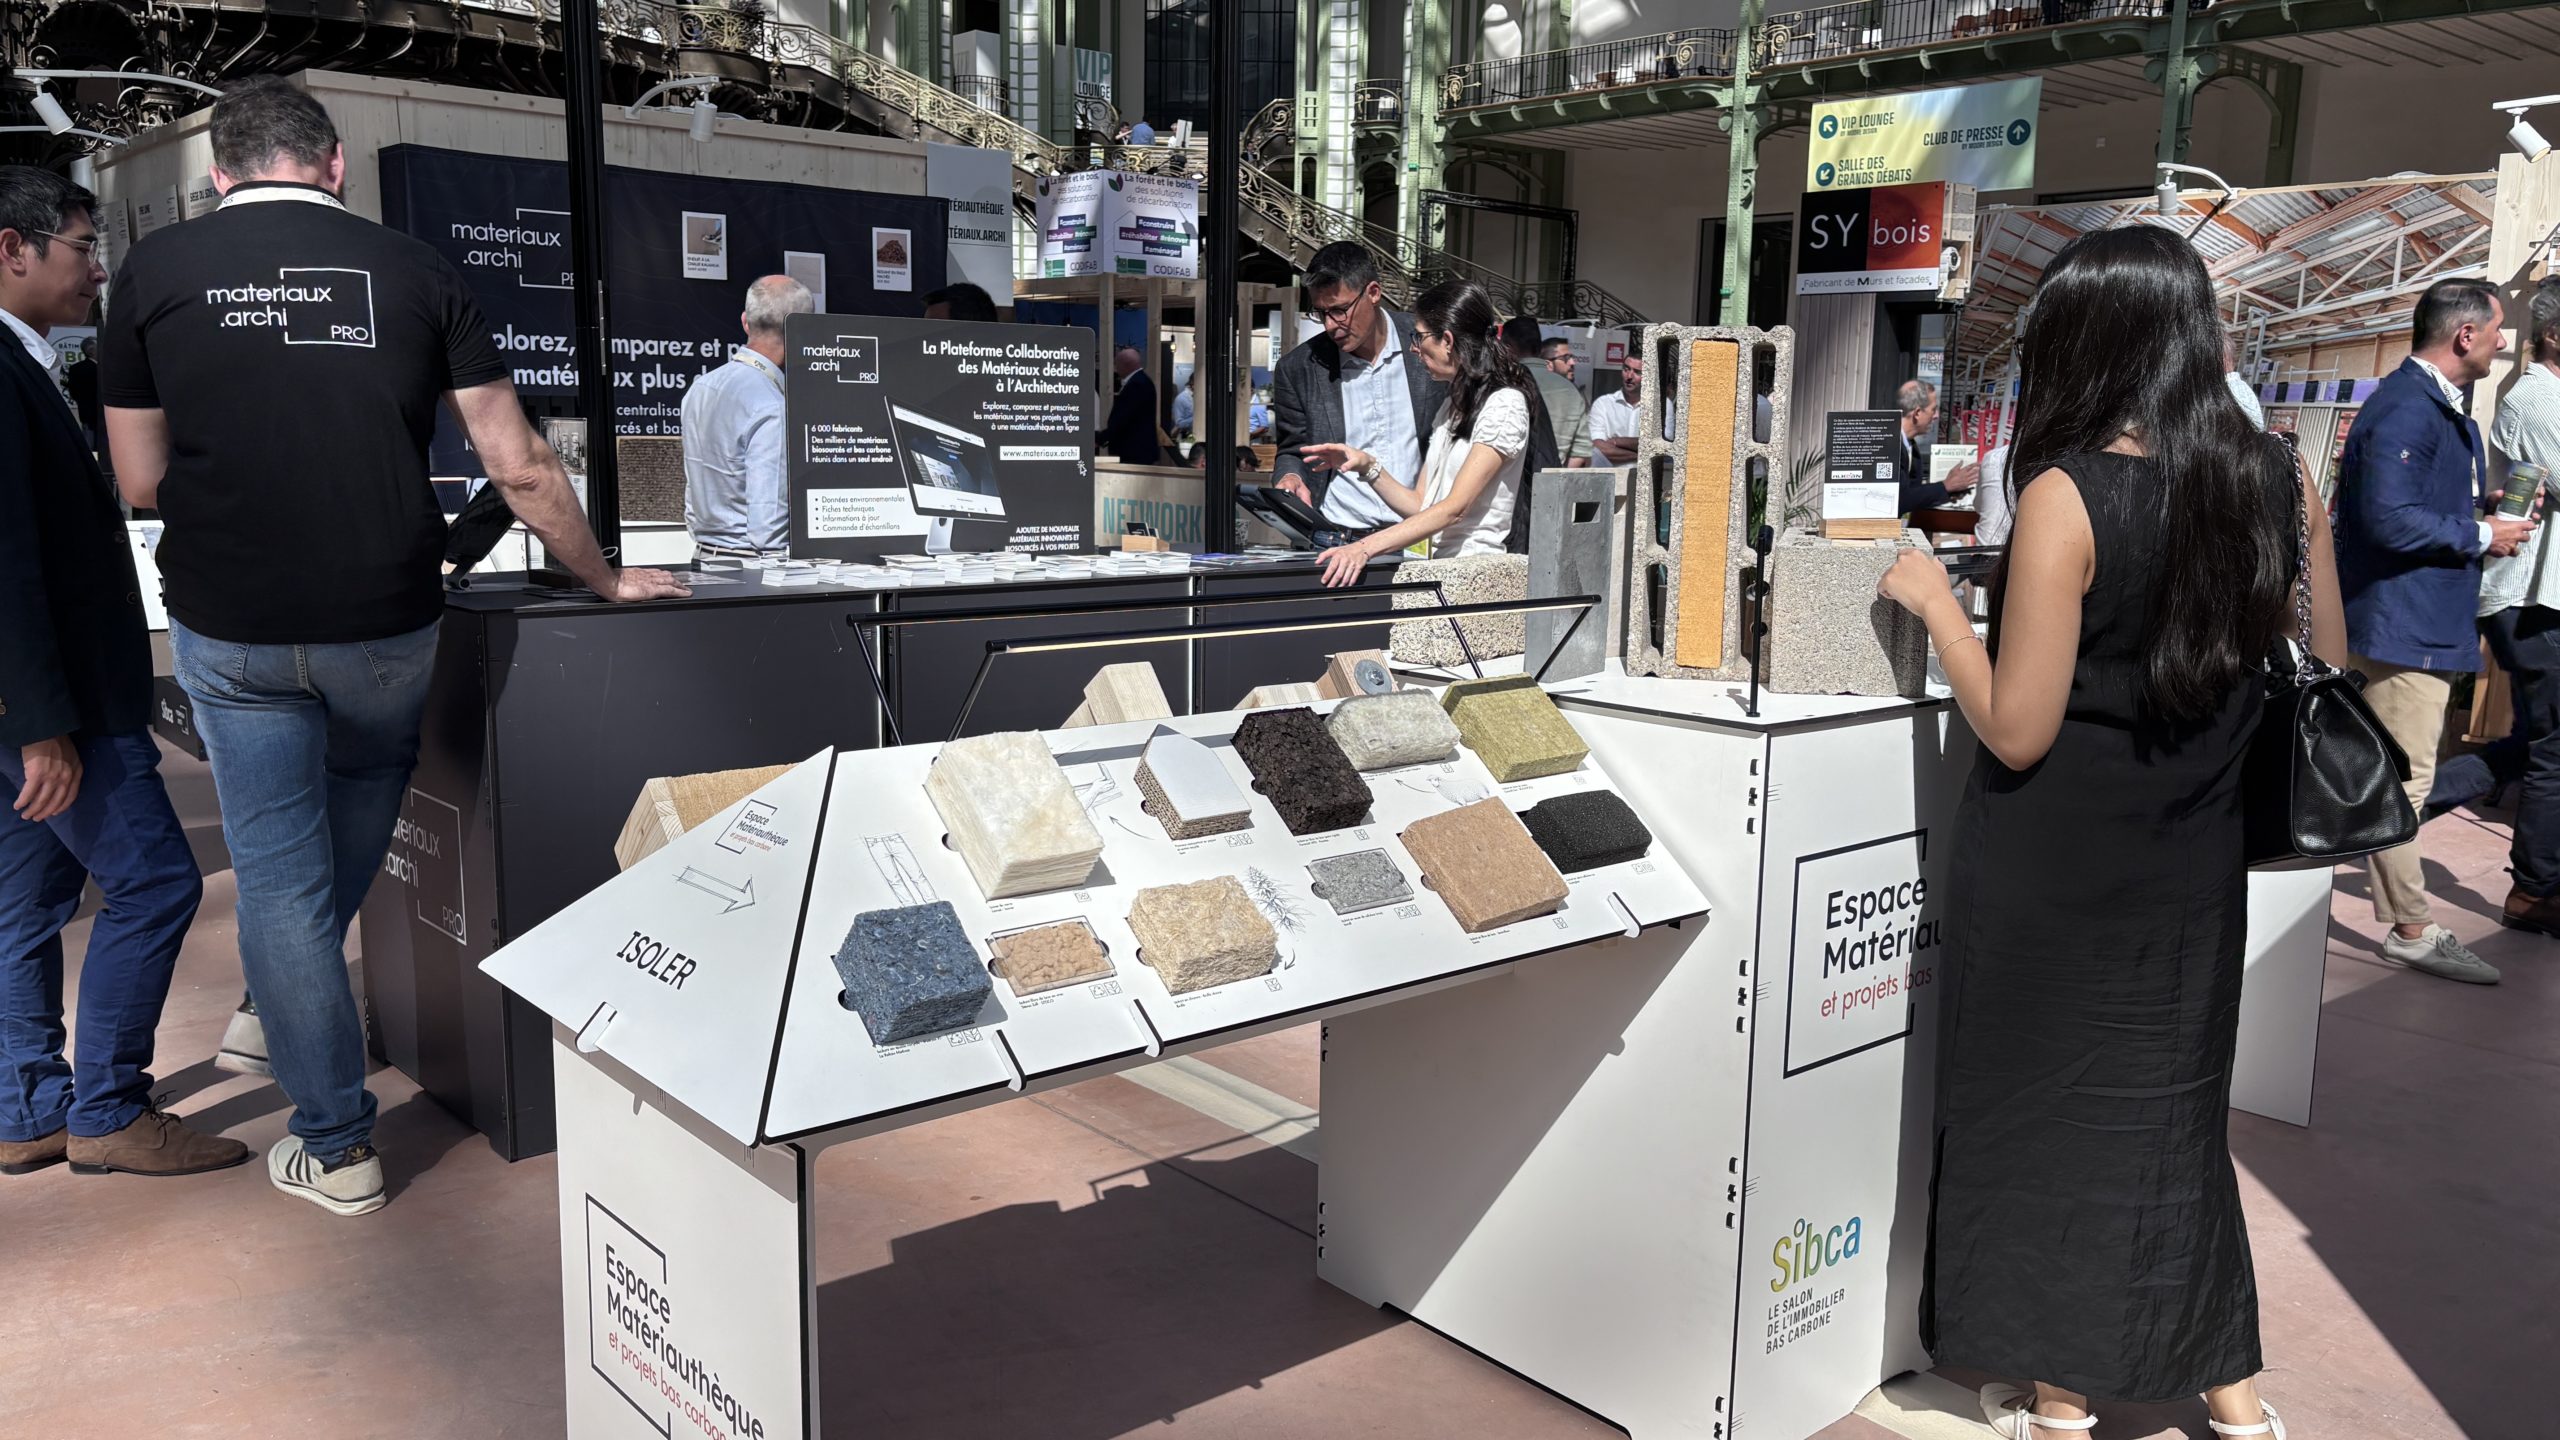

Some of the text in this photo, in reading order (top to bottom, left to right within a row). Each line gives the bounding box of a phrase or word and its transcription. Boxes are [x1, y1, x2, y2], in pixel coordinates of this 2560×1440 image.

[1076, 48, 1111, 83] VIP
[1078, 82, 1110, 98] LOUNGE
[1841, 112, 1895, 129] VIP LOUNGE
[1923, 125, 2004, 146] CLUB DE PRESSE
[1838, 156, 1884, 171] SALLE DES
[1124, 174, 1194, 190] La forêt et le bois,
[1837, 167, 1912, 186] GRANDS DÉBATS
[1135, 186, 1184, 199] des solutions
[949, 198, 1004, 216] TÉRIAUTHÈQUE
[1126, 195, 1192, 209] de décarbonation
[1138, 219, 1174, 230] #construire
[1809, 213, 1931, 249] SY bois
[452, 222, 562, 247] materiaux
[948, 225, 1005, 243] TÉRIAUX.ARCHI
[1121, 231, 1189, 244] #réhabiliter #rénover
[463, 247, 522, 268] .archi
[1144, 245, 1181, 256] #aménager
[1070, 260, 1097, 271] CODIFAB
[1153, 264, 1190, 277] CODIFAB
[1804, 275, 1930, 288] Fabricant de Murs et façades
[206, 282, 332, 304] materiaux
[220, 305, 288, 327] .archi
[331, 325, 369, 340] PRO
[490, 323, 576, 356] plorez,
[611, 336, 694, 361] mparez
[700, 338, 721, 357] et
[803, 345, 861, 358] materiaux
[923, 340, 1079, 361] La Plateforme Collaborative
[808, 359, 839, 371] .archi
[958, 359, 1079, 377] des Matériaux dédiée
[641, 363, 686, 395] plus
[859, 372, 877, 381] PRO
[996, 378, 1079, 394] à l'Architecture
[616, 402, 682, 417] centralisa
[982, 401, 1011, 412] Explorez,
[1012, 404, 1042, 412] comparez
[1050, 404, 1079, 412] prescrivez
[974, 411, 982, 420] les
[983, 412, 1014, 420] matériaux
[1015, 414, 1029, 422] pour
[1042, 413, 1061, 423] projets
[1062, 414, 1079, 423] grâce
[615, 422, 641, 435] rcés
[646, 422, 658, 435] et
[811, 424, 863, 433] 6 000 fabricants
[991, 422, 996, 431] à
[1010, 422, 1055, 433] matériauthèque
[1065, 422, 1079, 434] ligne
[812, 435, 888, 444] Des milliers de matériaux
[812, 445, 845, 454] biosourcés
[1003, 448, 1078, 458] www.materiaux.archi
[812, 455, 831, 463] réunis
[832, 455, 847, 463] dans
[858, 455, 870, 463] seul
[871, 455, 893, 463] endroit
[821, 505, 875, 513] Fiches techniques
[867, 515, 880, 523] jour
[1103, 497, 1202, 544] NETWORK
[822, 524, 858, 532] Commande
[1016, 526, 1040, 534] AJOUTEZ
[1049, 525, 1080, 533] NOUVEAUX
[1009, 534, 1040, 543] MATÉRIAUX
[1041, 534, 1072, 542] INNOVANTS
[1005, 542, 1080, 553] BIOSOURCÉS À VOS PROJETS
[745, 810, 769, 826] Espace
[736, 820, 789, 846] Matériauthèque
[385, 851, 418, 888] .archi
[1826, 877, 1928, 932] Espace
[442, 905, 464, 936] PRO
[616, 930, 697, 990] ISOLER
[1820, 962, 1932, 1020] et projets bas
[606, 1243, 671, 1324] Espace
[1768, 1287, 1813, 1321] LE SALON
[1767, 1288, 1845, 1338] DE L'IMMOBILIER
[1766, 1310, 1831, 1354] BAS CARBONE
[607, 1283, 764, 1440] Matériauthèque
[609, 1331, 619, 1351] et
[621, 1342, 657, 1387] projets
[660, 1366, 681, 1408] bas
